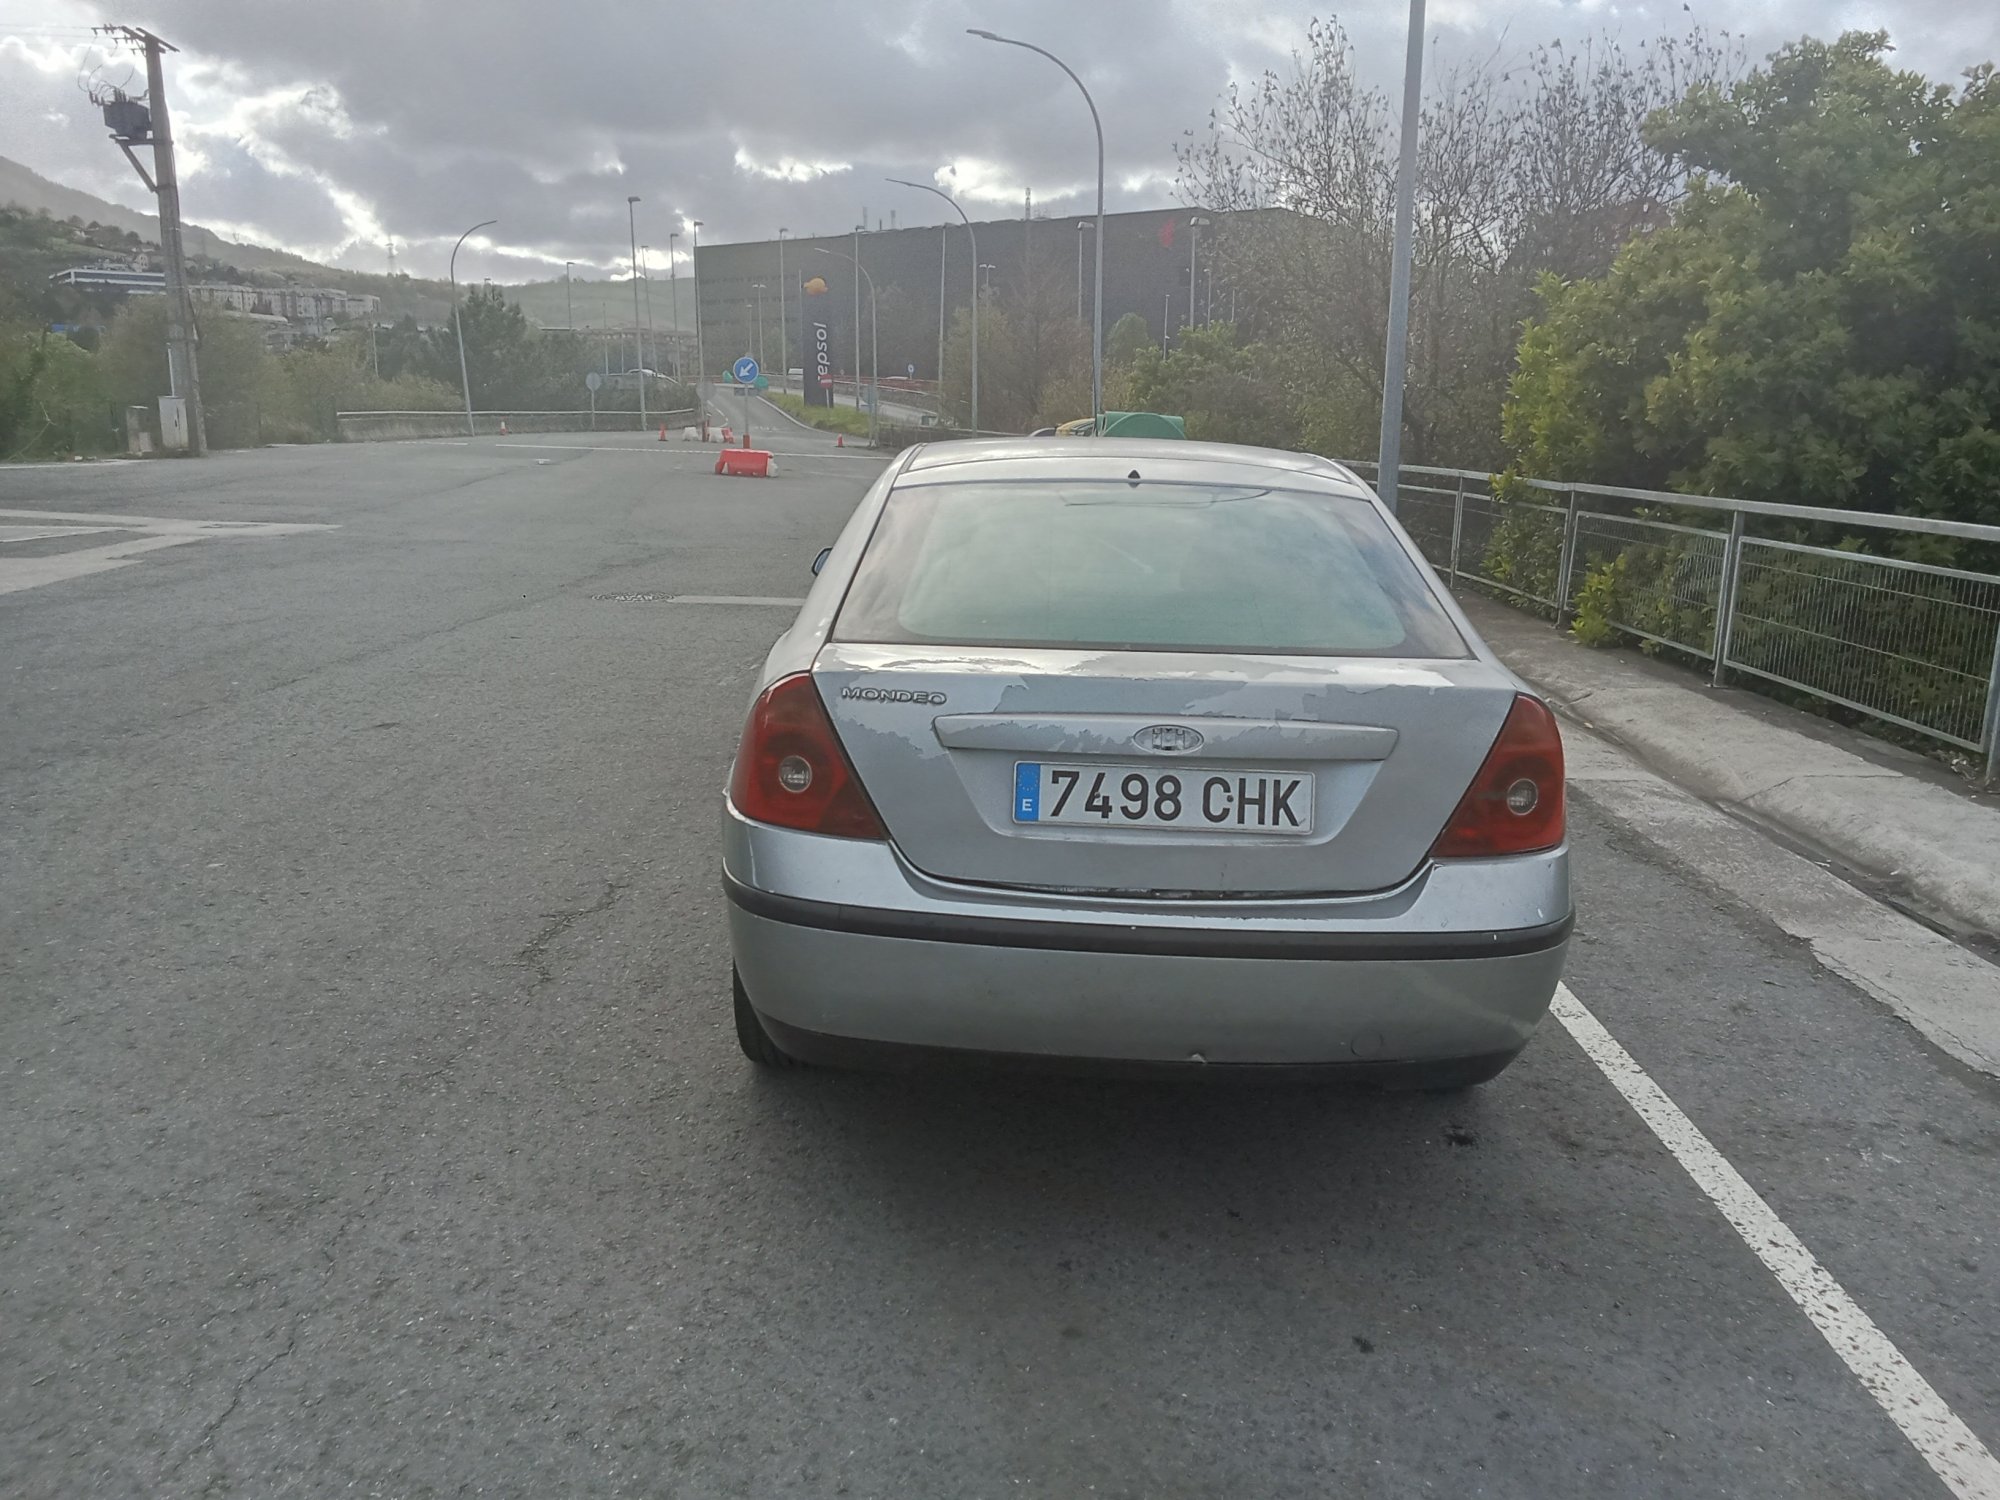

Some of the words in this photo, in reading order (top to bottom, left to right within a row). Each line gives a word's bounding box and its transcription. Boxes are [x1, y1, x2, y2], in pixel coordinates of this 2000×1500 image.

[841, 686, 947, 706] MONDEO
[1022, 798, 1032, 812] E
[1050, 770, 1182, 821] 7498
[1202, 776, 1301, 827] CHK
